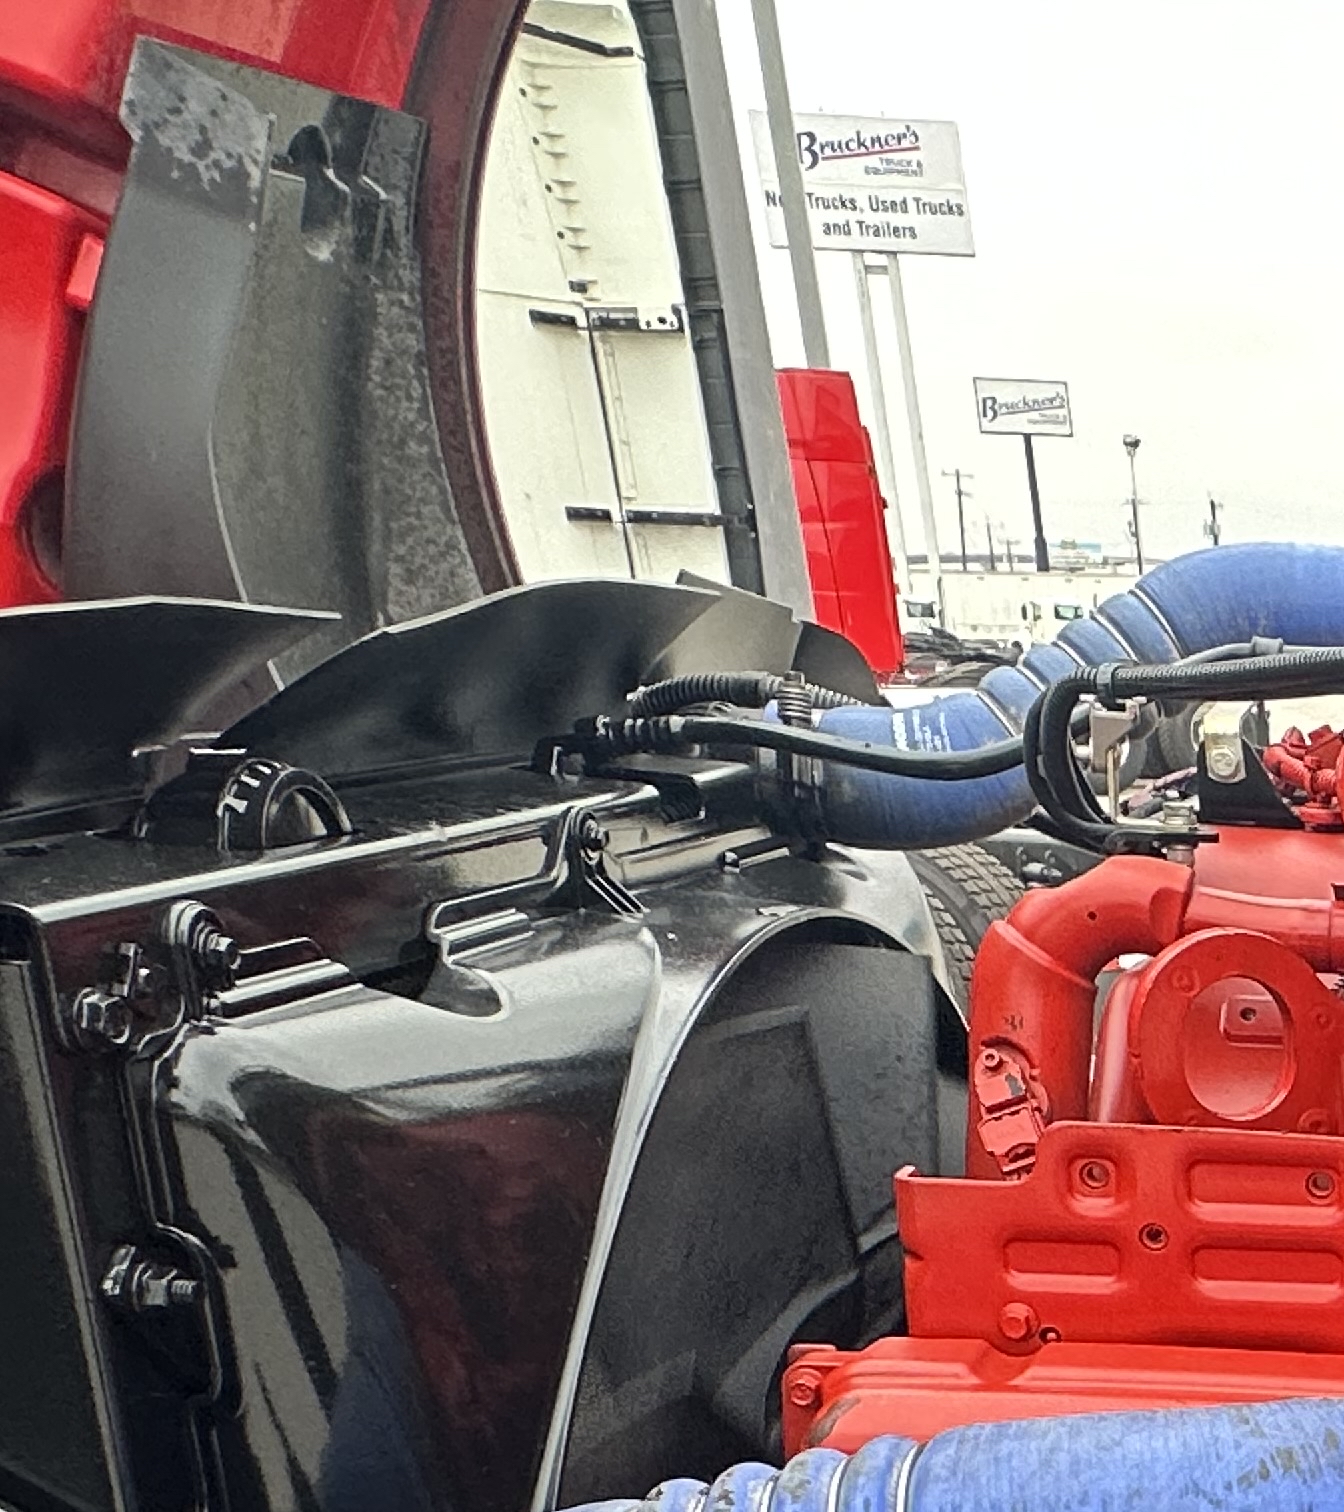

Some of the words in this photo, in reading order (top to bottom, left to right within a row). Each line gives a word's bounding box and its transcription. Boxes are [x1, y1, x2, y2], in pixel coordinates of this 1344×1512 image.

[796, 124, 921, 171] Bruckner's
[806, 192, 864, 214] Trucks,
[868, 193, 909, 215] Used
[912, 196, 965, 217] Trucks
[822, 219, 852, 237] and
[855, 220, 918, 240] Trailers
[982, 391, 1066, 423] Bruckner's
